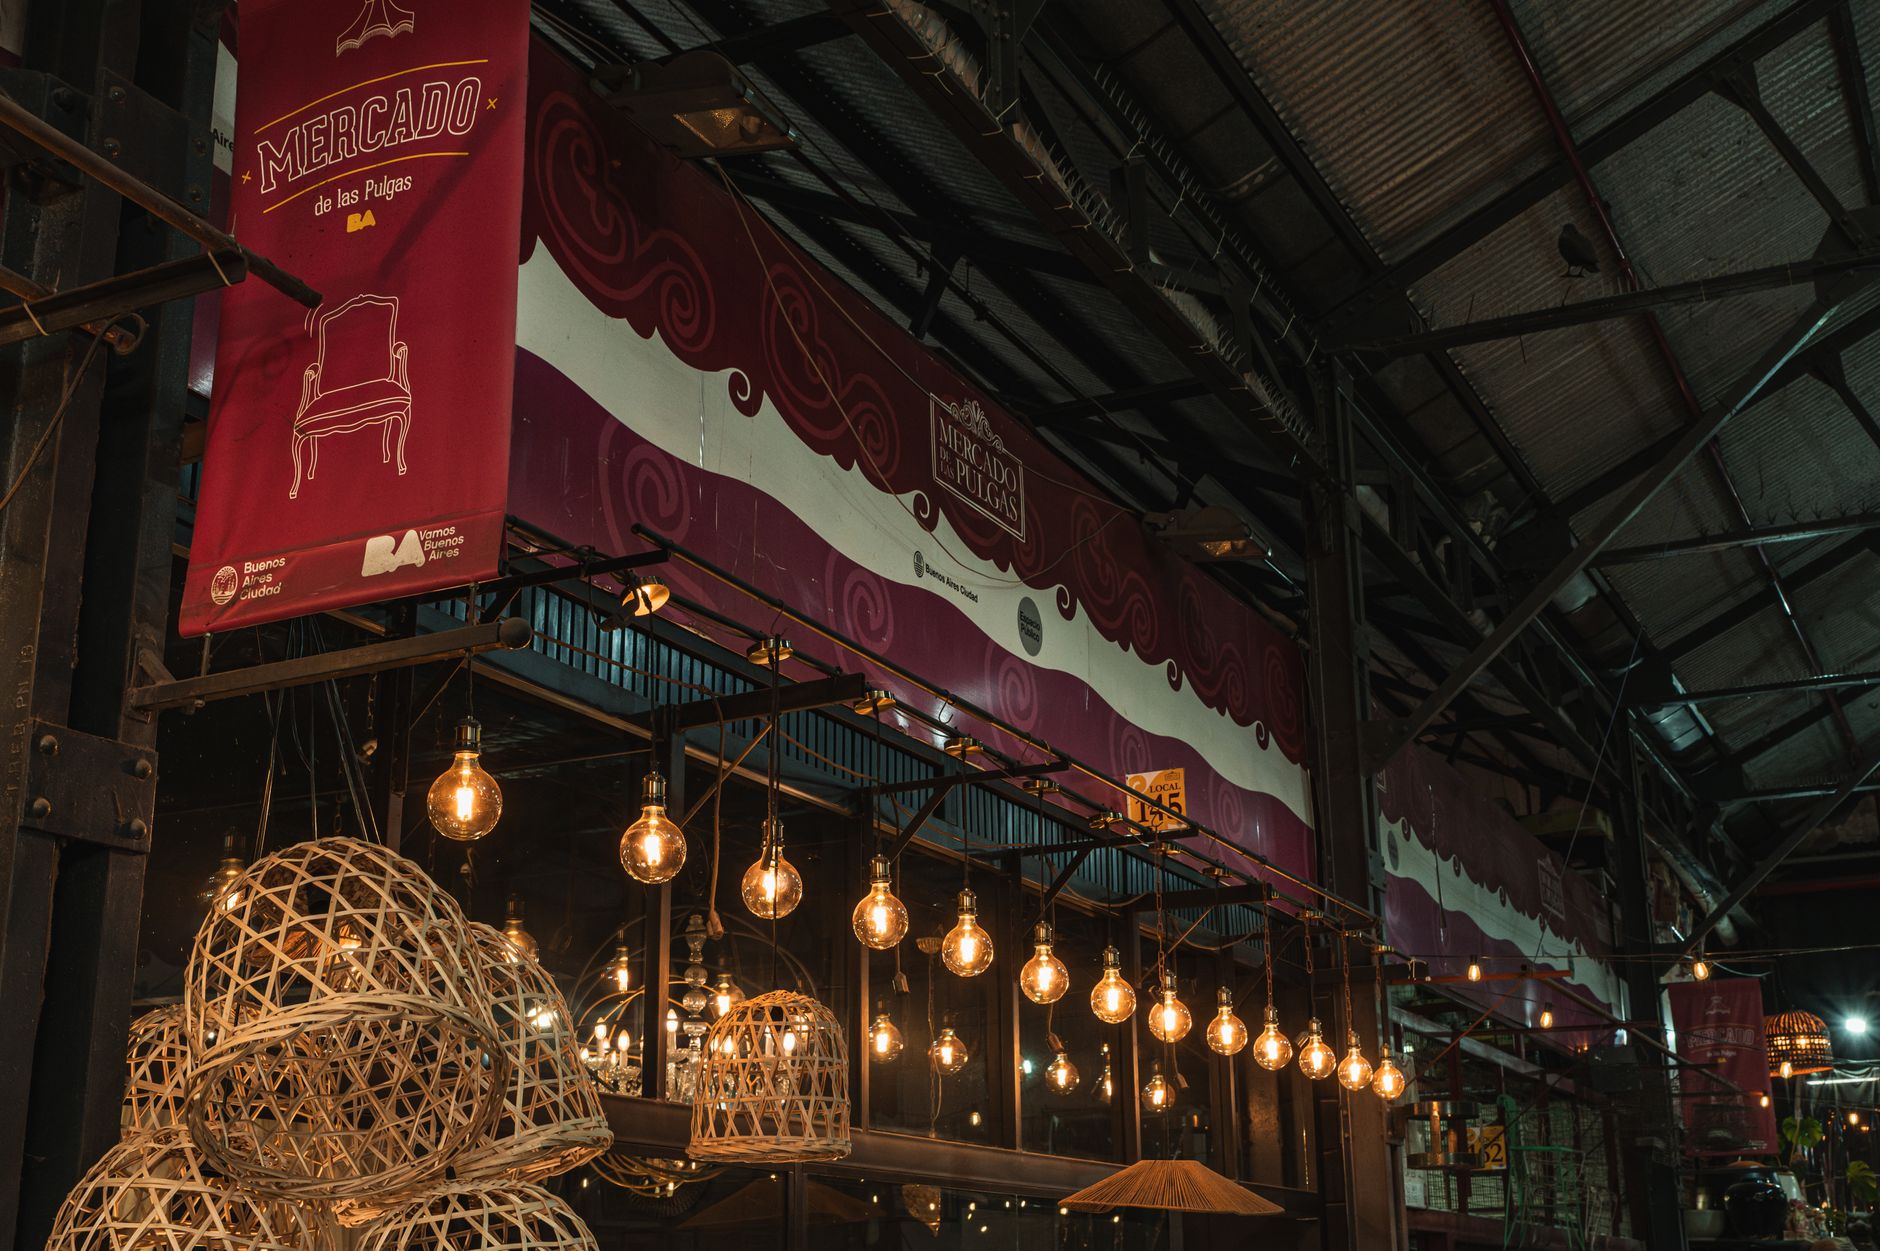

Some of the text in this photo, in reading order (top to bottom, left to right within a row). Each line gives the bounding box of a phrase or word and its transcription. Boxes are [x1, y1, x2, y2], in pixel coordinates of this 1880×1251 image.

[257, 76, 482, 194] MERCADO
[314, 174, 413, 216] de las Pulgas
[939, 415, 1017, 493] MERCADO
[956, 457, 1018, 522] PULGAS
[419, 526, 456, 541] Vamos
[424, 535, 464, 551] Buenos
[428, 547, 460, 562] Aires
[244, 557, 286, 574] Buenos
[242, 573, 273, 588] Aires
[925, 563, 979, 603] Buenos Aires Ciudad
[240, 582, 282, 601] Ciudad
[1149, 781, 1181, 794] LOCAL
